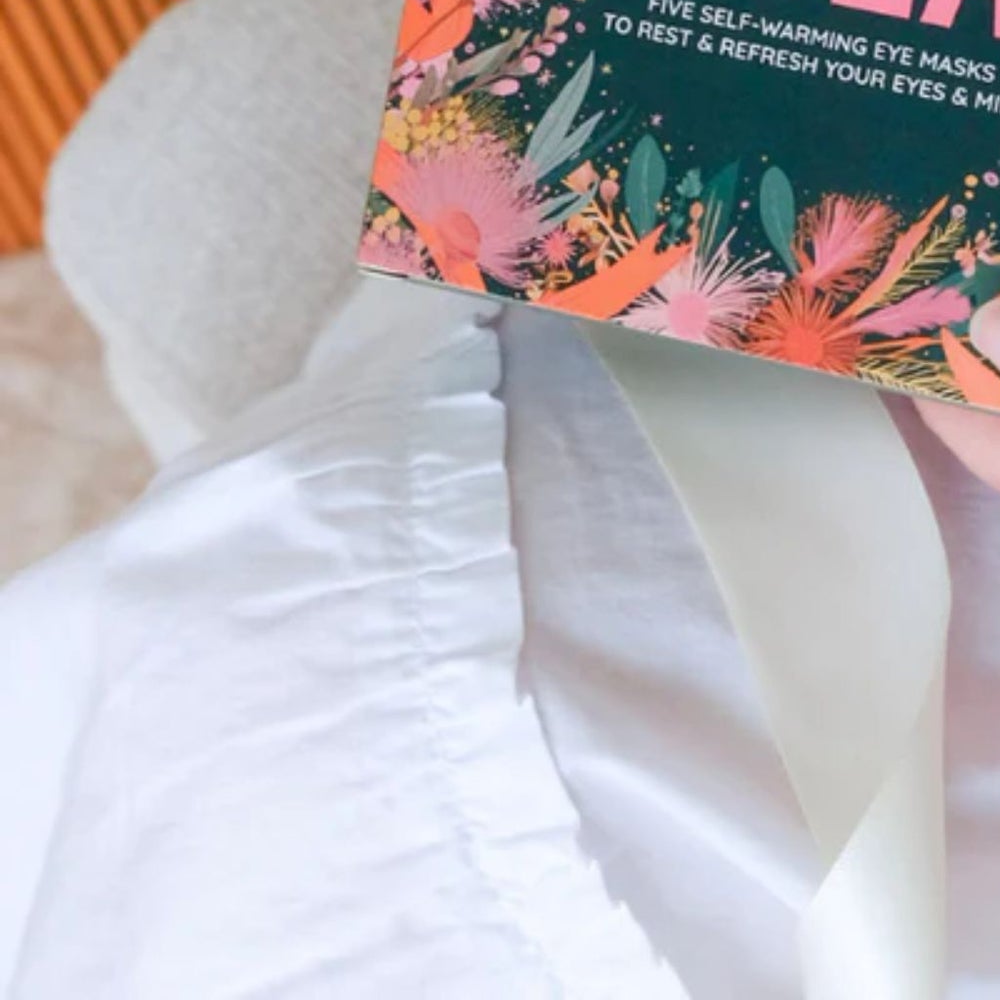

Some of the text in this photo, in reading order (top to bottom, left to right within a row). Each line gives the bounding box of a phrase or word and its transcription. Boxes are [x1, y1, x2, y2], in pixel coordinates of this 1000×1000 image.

[603, 12, 633, 35] TO
[637, 20, 693, 47] REST
[697, 34, 713, 52] &
[719, 37, 819, 74] REFRESH
[825, 59, 886, 89] YOUR
[891, 74, 946, 101] EYES
[951, 86, 968, 106] &
[699, 5, 868, 56] SELF-WARMING
[873, 41, 913, 66] EYE
[919, 51, 996, 83] MASKS
